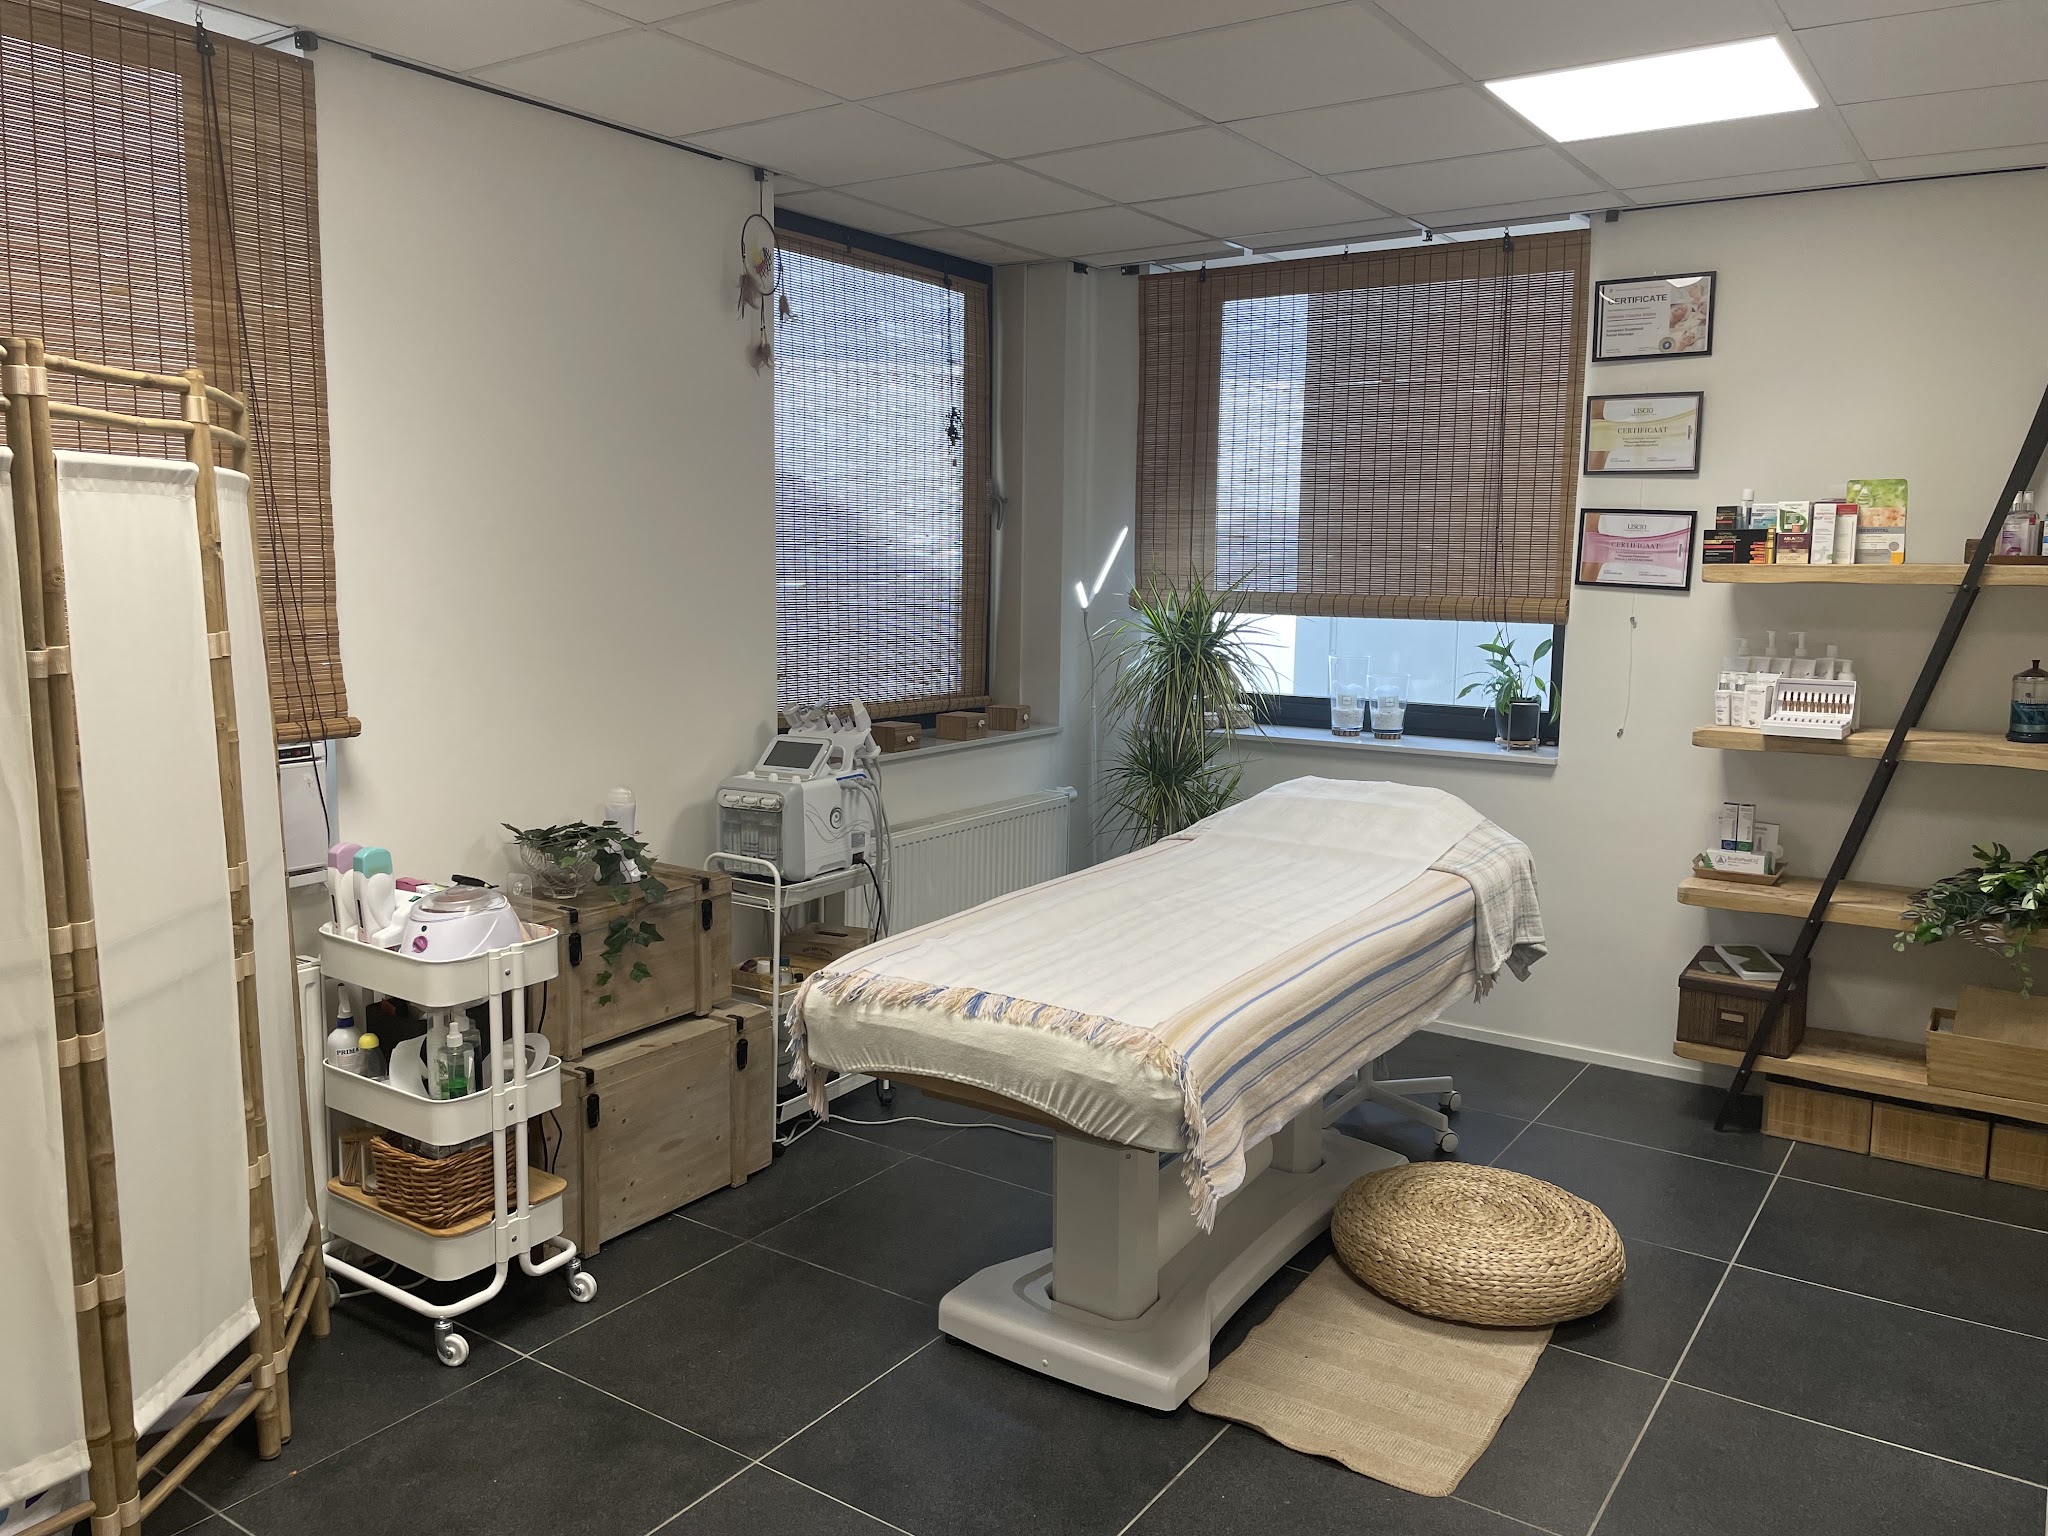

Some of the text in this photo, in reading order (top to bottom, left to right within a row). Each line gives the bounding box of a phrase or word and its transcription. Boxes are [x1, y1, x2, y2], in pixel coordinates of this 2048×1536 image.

[1607, 294, 1668, 306] CERTIFICATE
[1617, 426, 1668, 434] CERTIFICAAT
[1610, 541, 1661, 550] CERTIFICAAT
[336, 1047, 360, 1055] PRIMA
